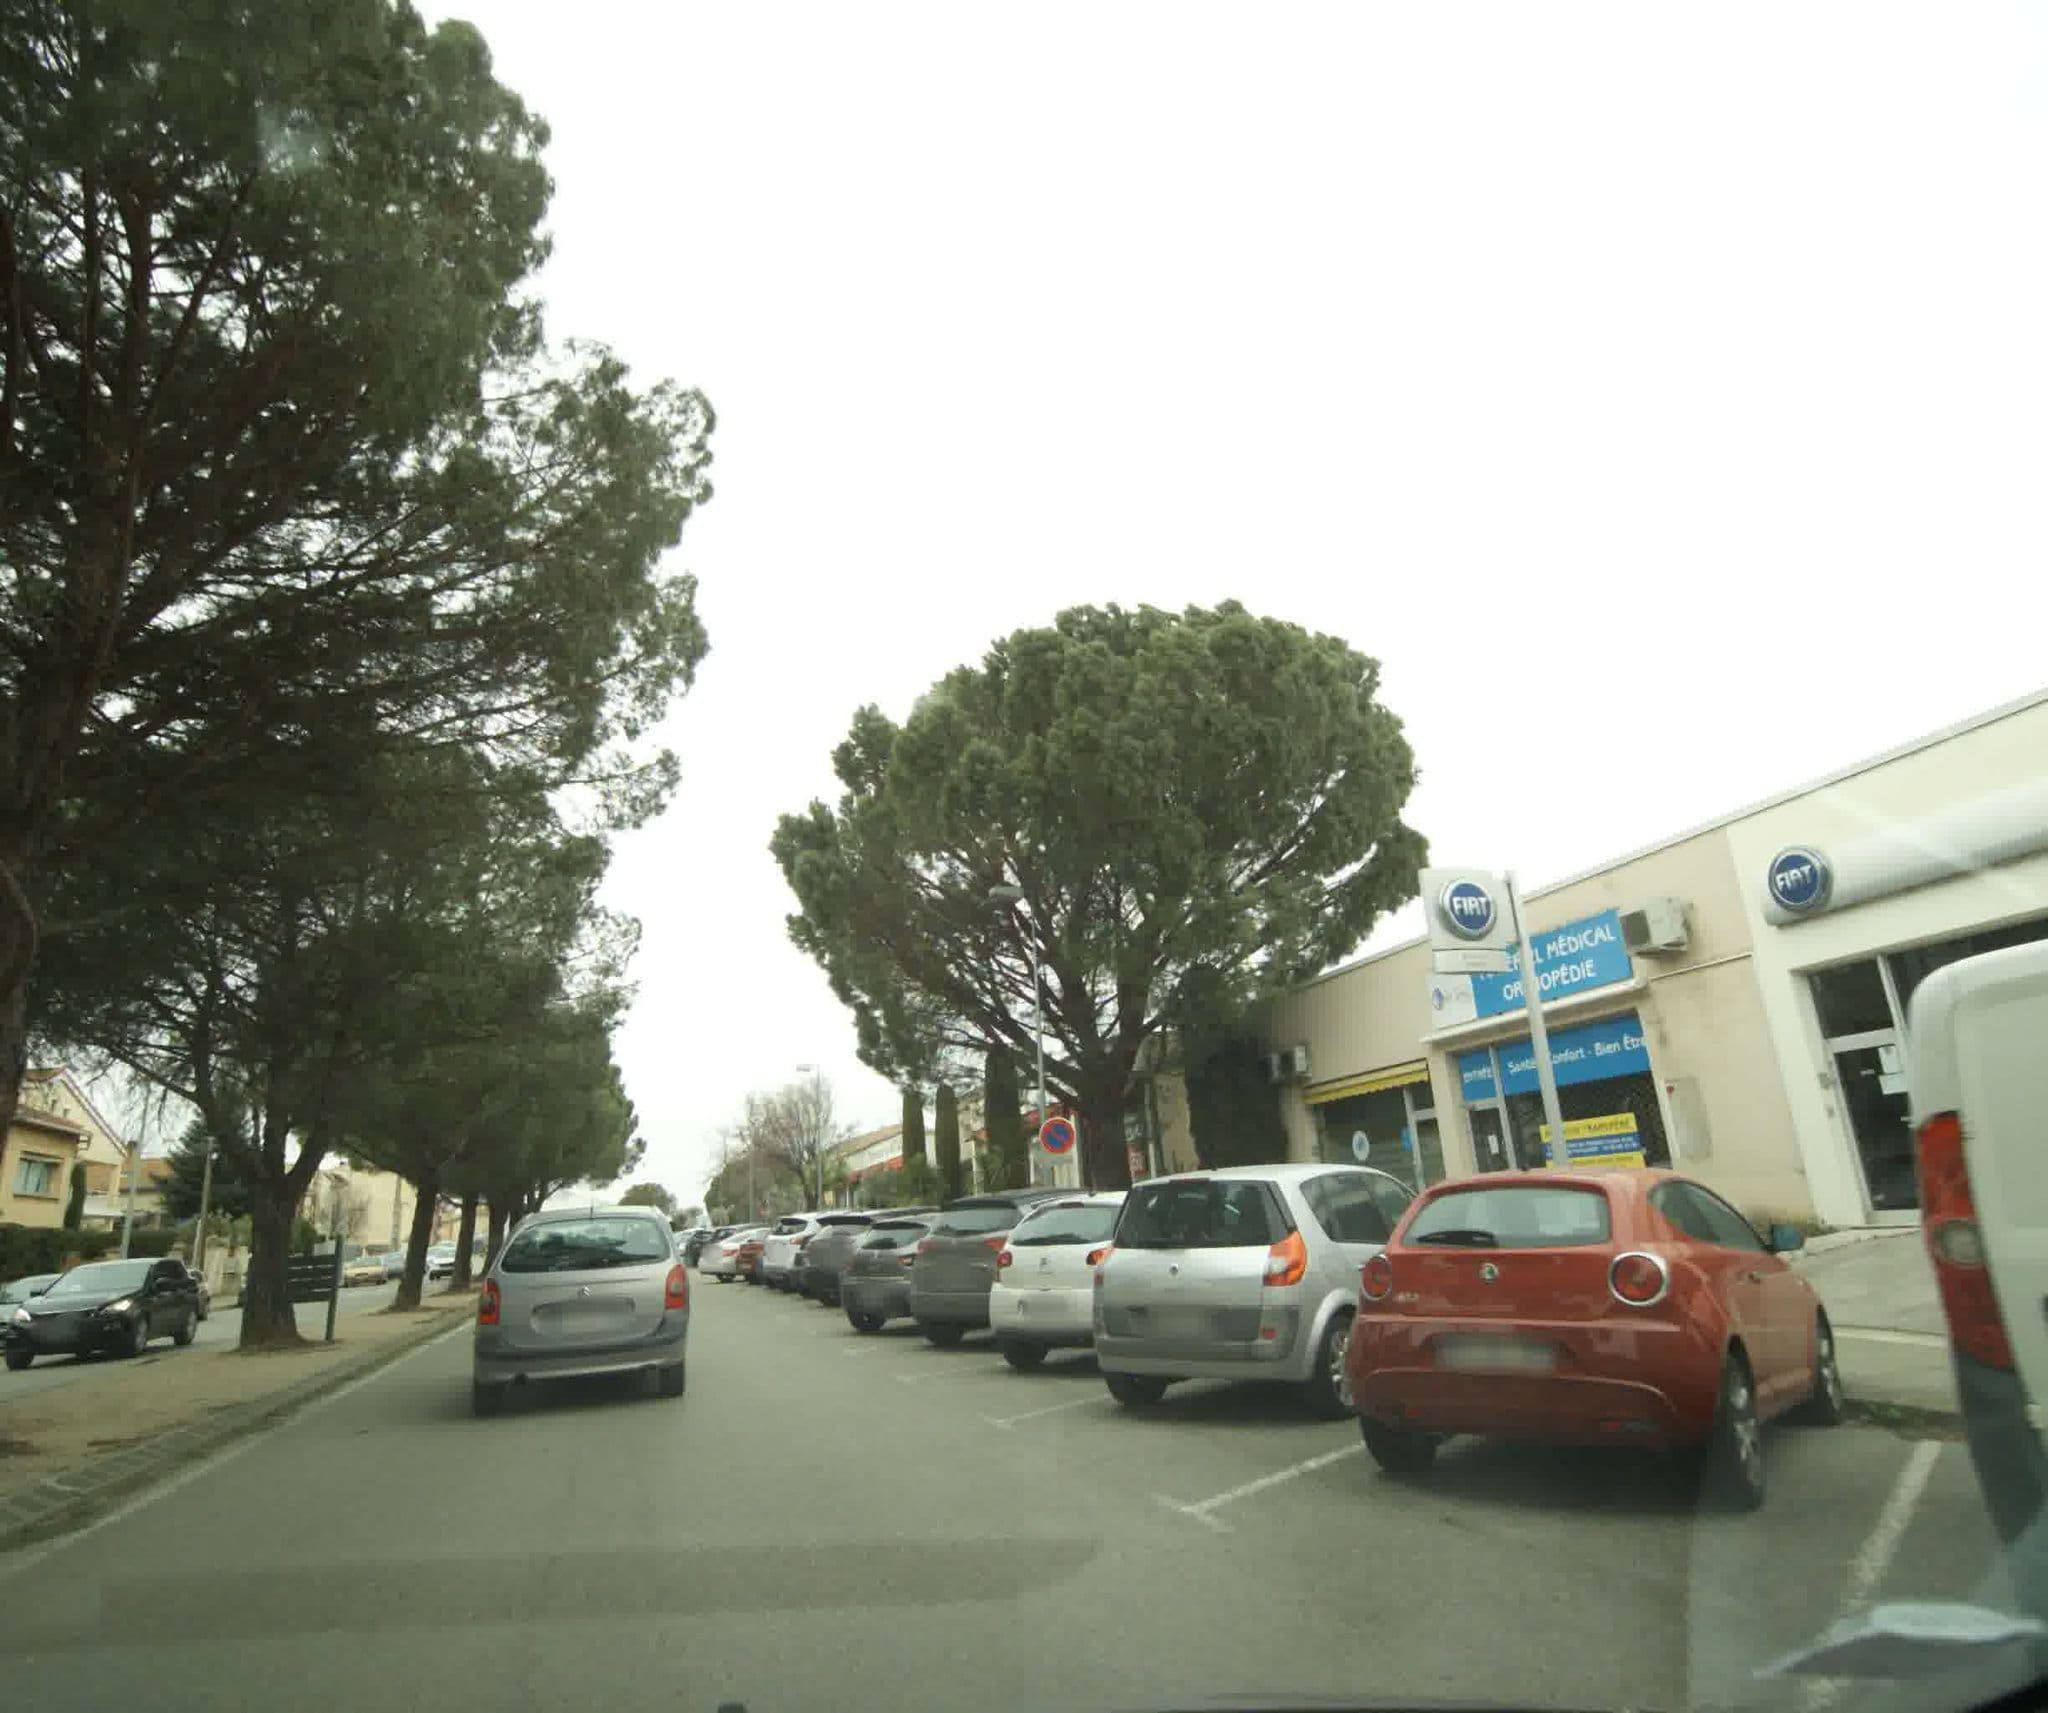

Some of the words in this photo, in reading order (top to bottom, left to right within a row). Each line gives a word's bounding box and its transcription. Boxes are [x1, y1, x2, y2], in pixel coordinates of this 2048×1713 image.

[1776, 864, 1811, 891] FIAT
[1452, 895, 1491, 917] FIAT
[1547, 923, 1617, 960] MÉDICAL
[1502, 958, 1597, 1001] OROPÉDIE
[1552, 1047, 1586, 1065] onfort
[1593, 1040, 1621, 1058] Bien
